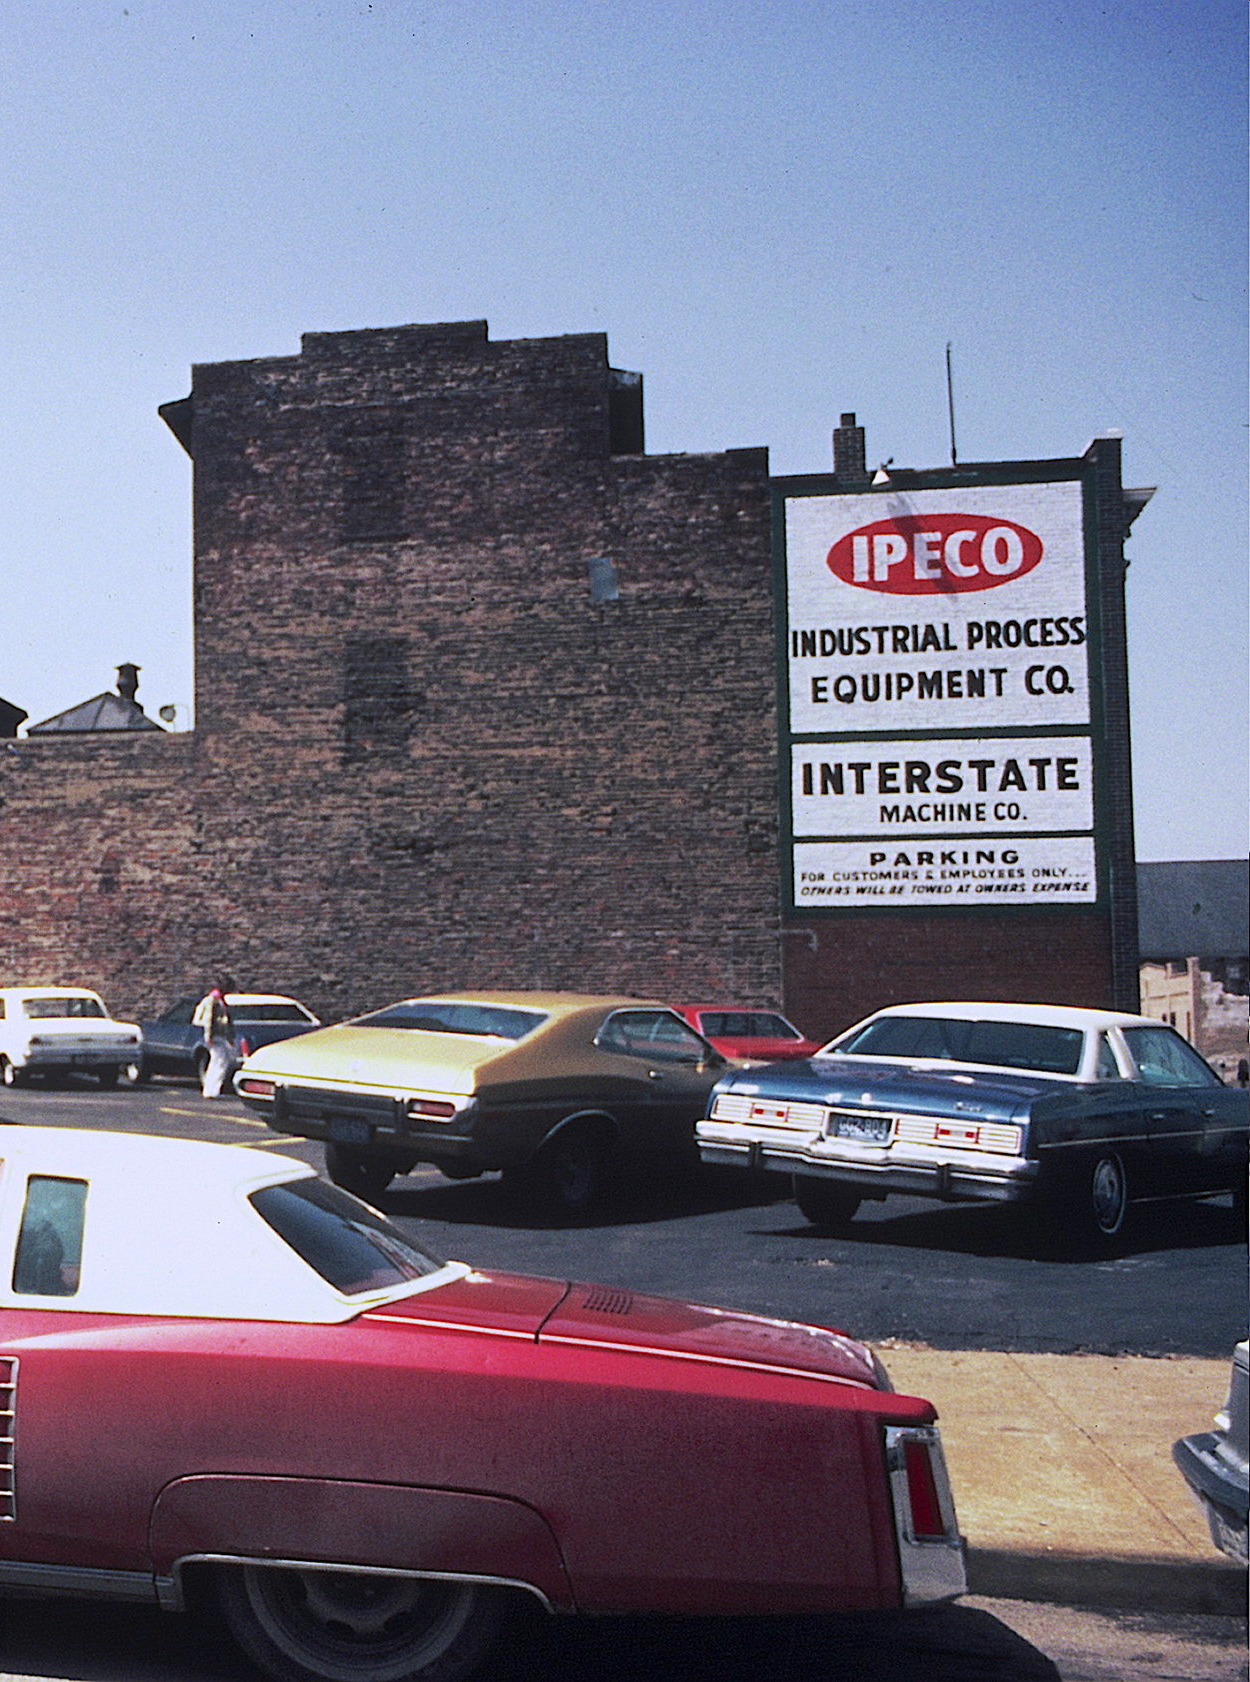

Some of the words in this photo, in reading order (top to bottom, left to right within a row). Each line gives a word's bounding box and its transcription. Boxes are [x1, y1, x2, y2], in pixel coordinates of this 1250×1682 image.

[852, 526, 1024, 582] IPECO
[792, 623, 957, 657] INDUSTRIAL
[967, 615, 1086, 650] PROCESS
[812, 668, 1007, 704] EQUIPMENT
[1025, 665, 1075, 695] CO.
[803, 758, 1079, 795] INTERSTATE
[880, 803, 986, 822] MACHINE
[994, 802, 1027, 820] CO.
[870, 850, 1018, 866] PARKING
[801, 872, 825, 882] FOR
[833, 870, 918, 881] CUSTOMERS
[940, 868, 1025, 880] EMPLOYEES
[801, 886, 850, 896] OTHERS
[856, 886, 885, 895] WILL
[889, 885, 905, 895] BE
[911, 884, 952, 894] TOWED
[956, 884, 971, 893] AT
[975, 883, 1026, 893] OWNERS
[1032, 882, 1090, 893] EXPENSE
